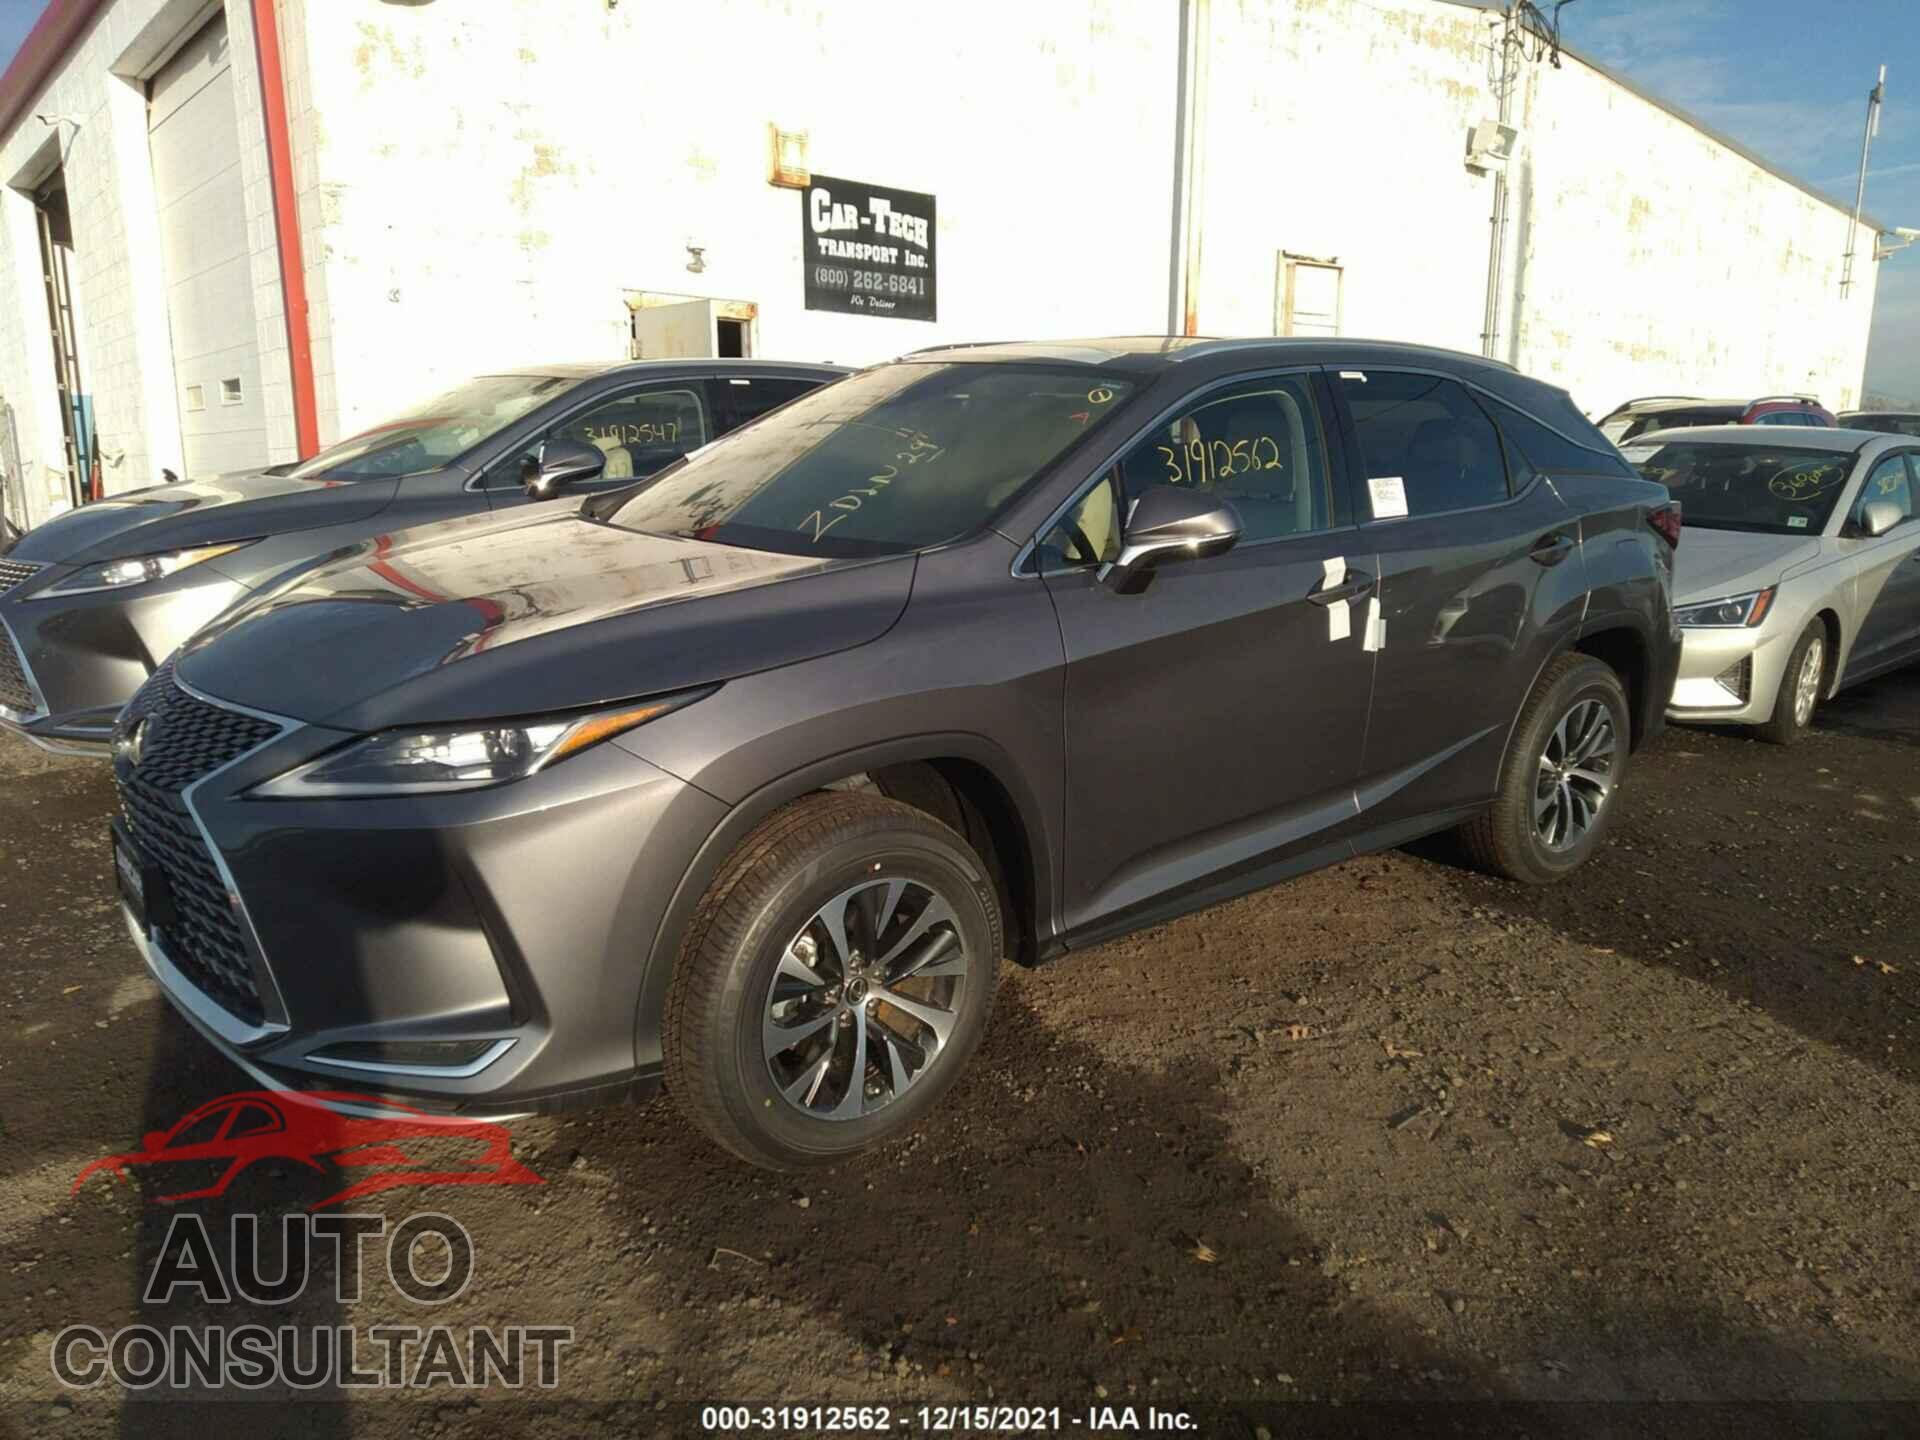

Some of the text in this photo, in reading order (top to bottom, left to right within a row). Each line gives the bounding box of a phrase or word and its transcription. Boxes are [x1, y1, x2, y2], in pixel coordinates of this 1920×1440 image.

[818, 237, 929, 269] TRANSPORT Inc.
[815, 266, 925, 296] (800) 262-6841
[583, 422, 677, 444] 31912547
[1157, 436, 1283, 483] 31912562
